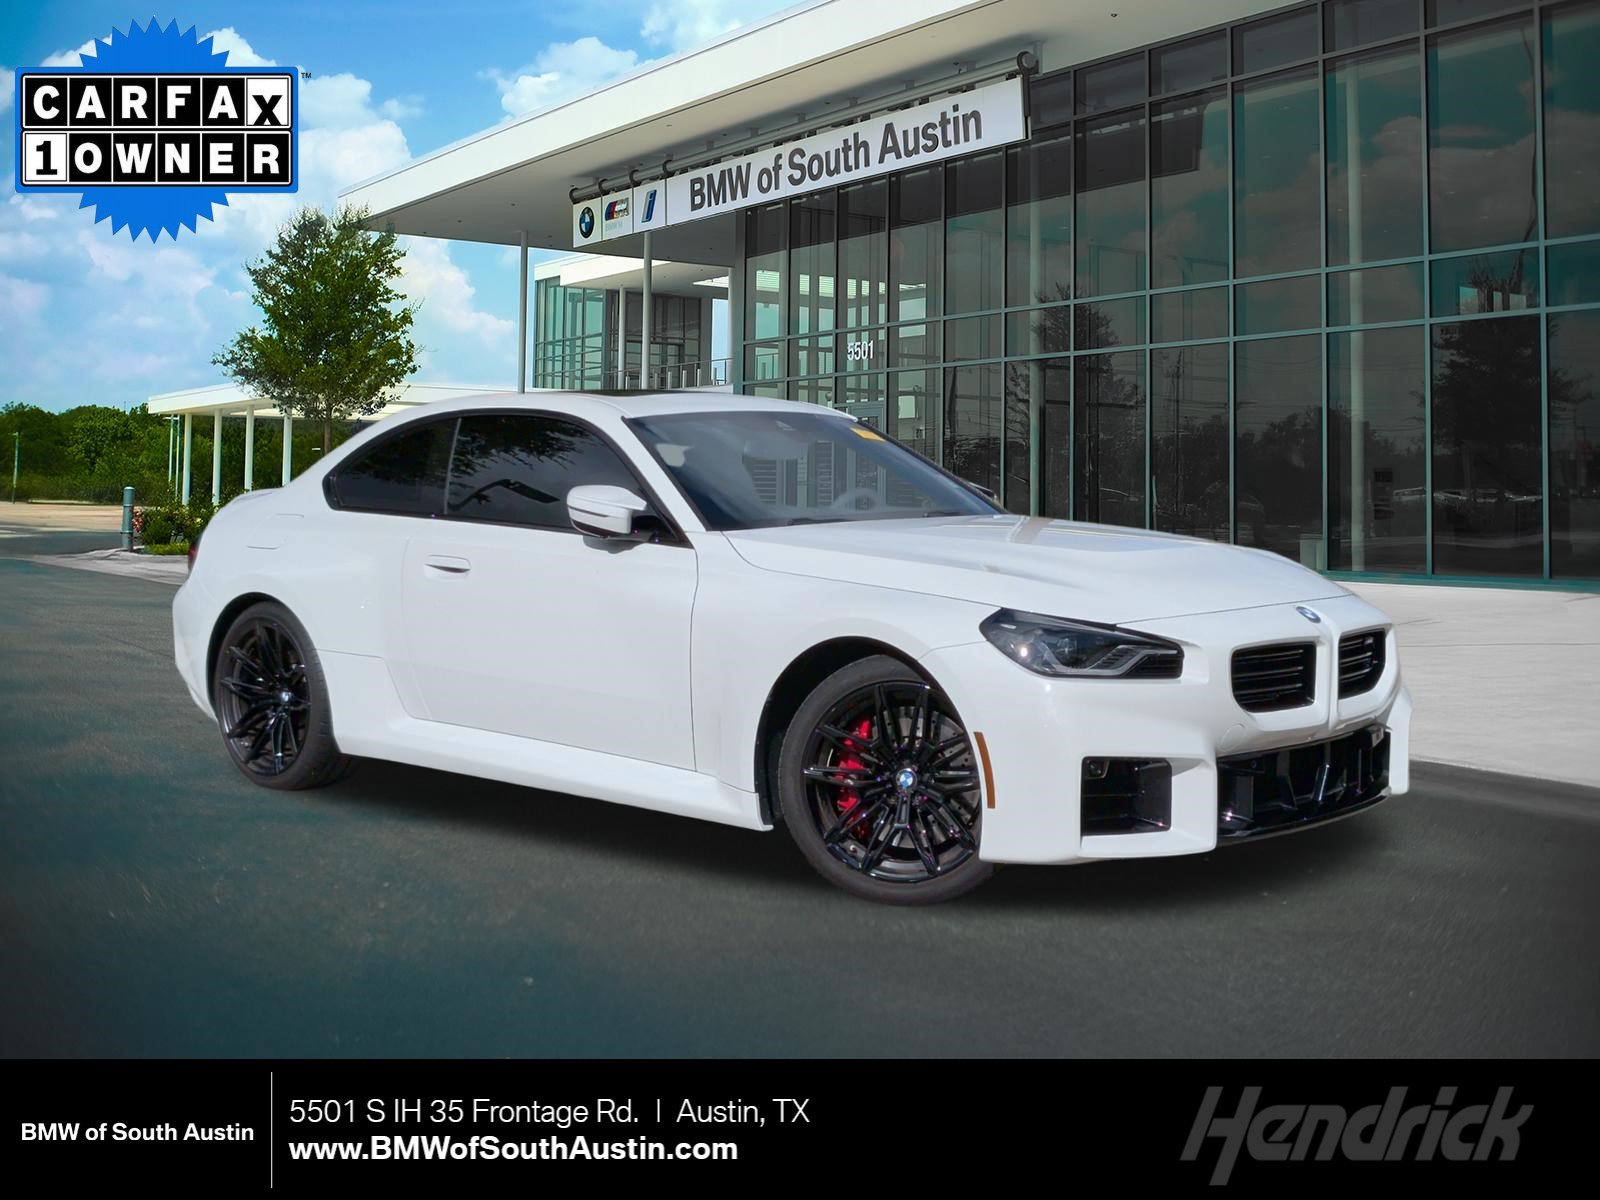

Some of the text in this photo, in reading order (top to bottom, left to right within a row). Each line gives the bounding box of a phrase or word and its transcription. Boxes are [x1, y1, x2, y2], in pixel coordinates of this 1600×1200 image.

[690, 104, 983, 211] BMW of South Austin
[847, 340, 874, 360] 5501
